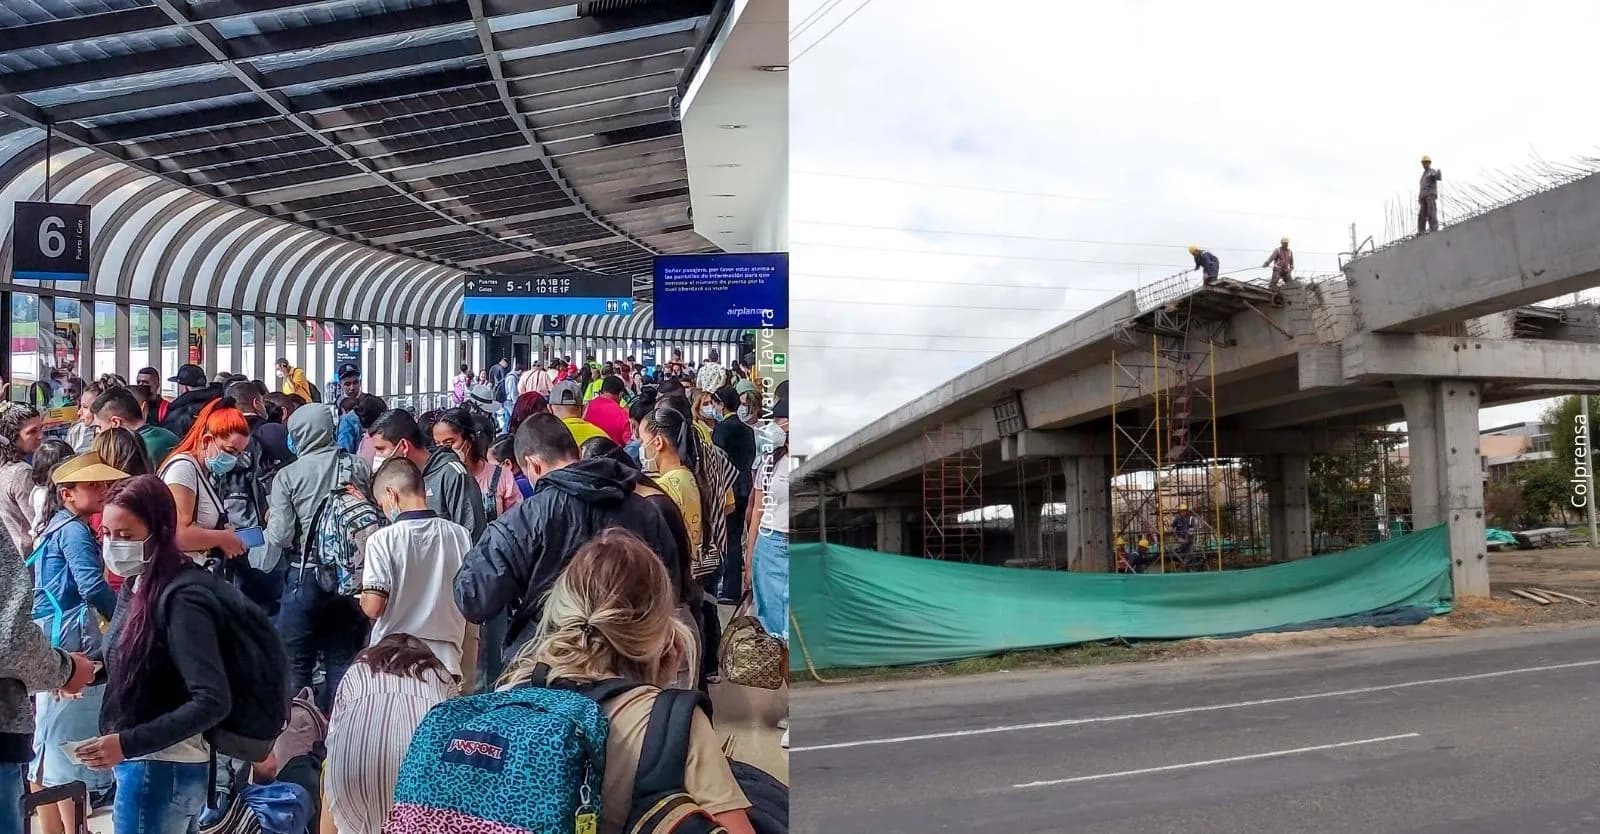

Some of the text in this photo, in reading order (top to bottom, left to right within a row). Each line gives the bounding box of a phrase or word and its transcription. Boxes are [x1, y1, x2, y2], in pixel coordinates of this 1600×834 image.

[38, 216, 66, 258] 6
[506, 281, 514, 292] 5
[525, 281, 531, 292] 1
[550, 314, 558, 327] 5
[337, 340, 350, 349] 5-1
[447, 739, 503, 759] JANSPORT
